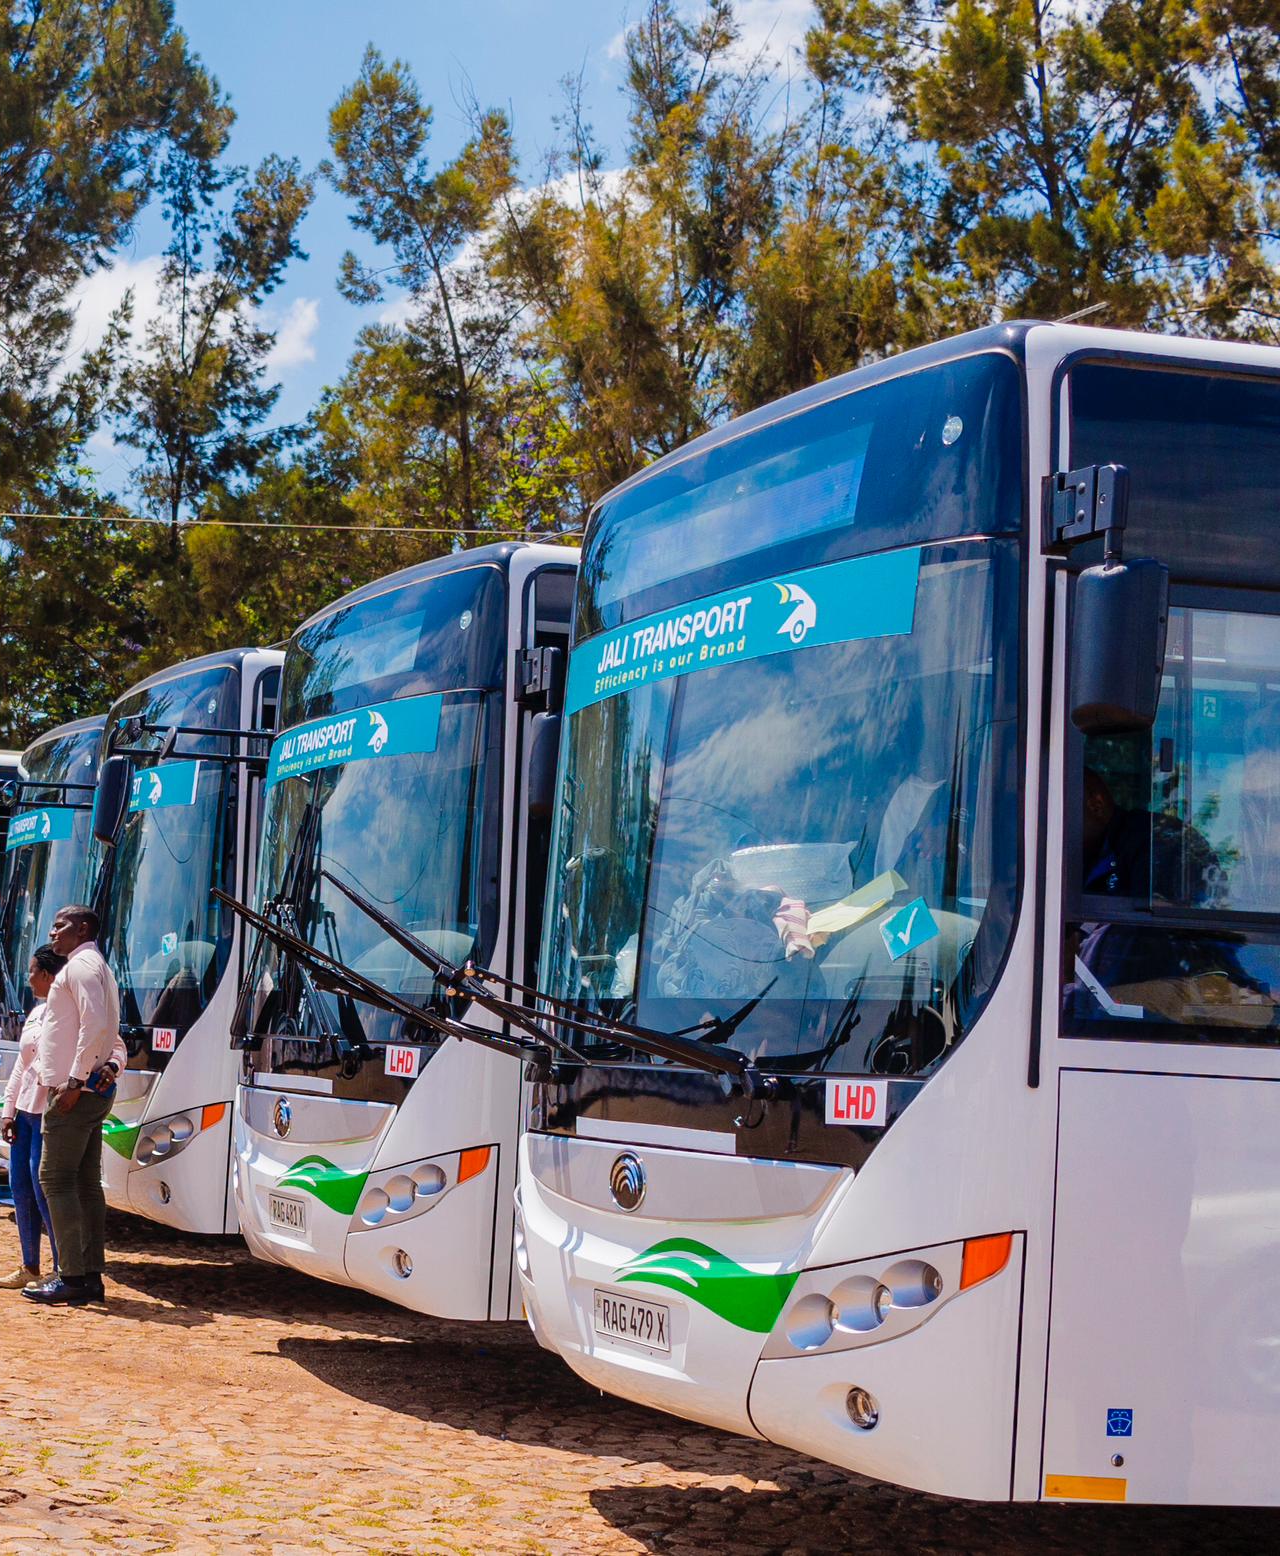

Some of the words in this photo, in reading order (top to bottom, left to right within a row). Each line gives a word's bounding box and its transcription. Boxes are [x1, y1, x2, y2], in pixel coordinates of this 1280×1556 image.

[597, 635, 629, 674] JALI
[632, 596, 752, 660] TRANSPORT
[594, 664, 648, 695] Efficiency
[652, 659, 664, 673] is
[669, 652, 694, 668] our
[699, 635, 746, 661] Brand
[280, 736, 297, 762] JALI
[296, 718, 357, 756] TRANSPORT
[328, 745, 352, 760] Brand
[155, 1030, 171, 1049] LHD
[390, 1048, 413, 1073] LHD
[833, 1084, 877, 1120] LHD
[272, 1199, 285, 1222] RAG
[286, 1203, 298, 1226] 481
[299, 1206, 304, 1228] X
[603, 1298, 627, 1333] RAG
[630, 1306, 654, 1341] 479
[657, 1312, 666, 1345] X
